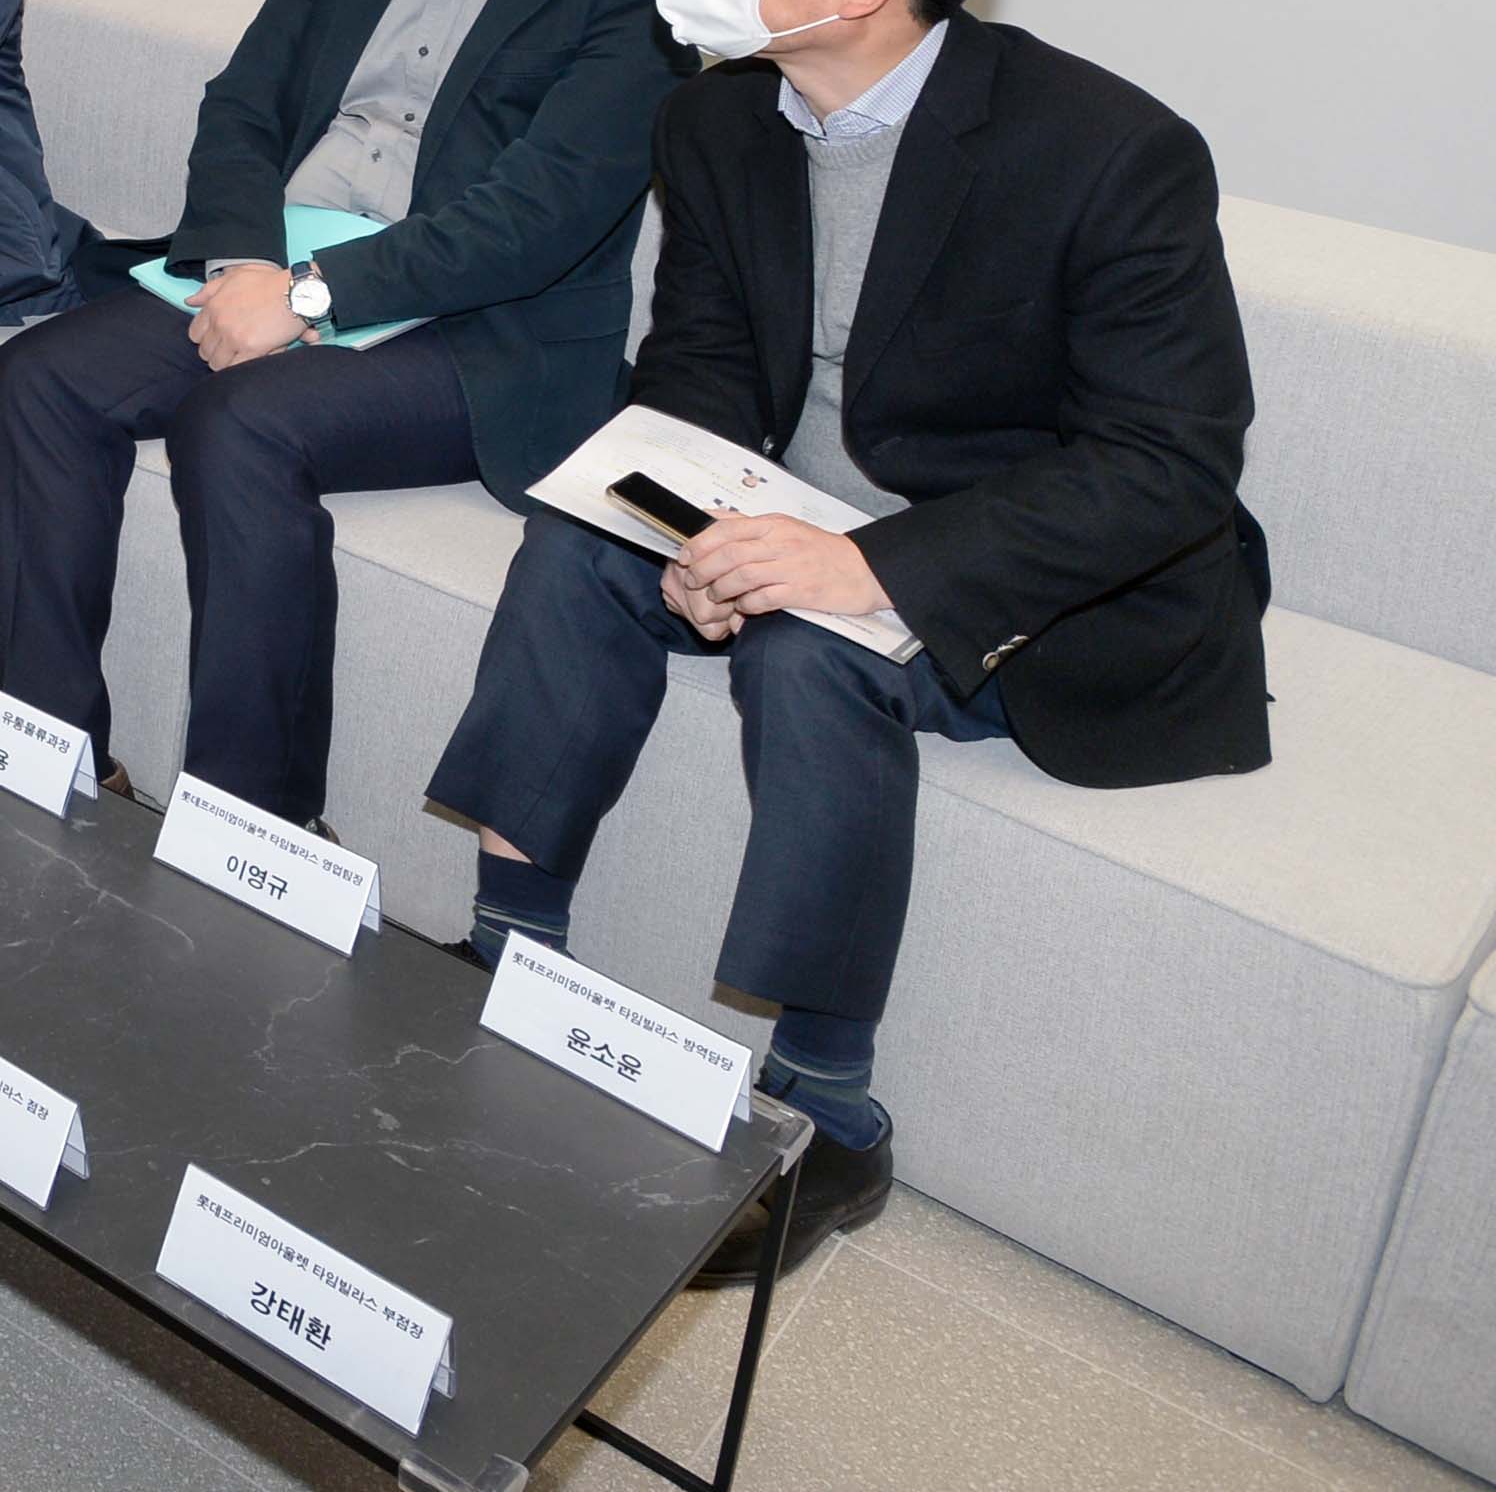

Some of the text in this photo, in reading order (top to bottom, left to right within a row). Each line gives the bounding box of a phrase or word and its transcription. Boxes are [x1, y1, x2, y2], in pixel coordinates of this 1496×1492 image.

[1, 710, 71, 755] 유통물류과장
[180, 790, 364, 887] 롯데프리미엄아울렛 타임빌라스 영업팀장
[226, 855, 289, 900] 이영규
[511, 951, 735, 1073] 롯데프리미엄아울렛 타임빌라스 방역담당
[565, 1026, 643, 1084] 윤소윤
[25, 1098, 50, 1121] 점장
[195, 1193, 425, 1340] 롯데프리미엄아울렛 타임빌라스 부점장
[249, 1280, 334, 1351] 강태환
